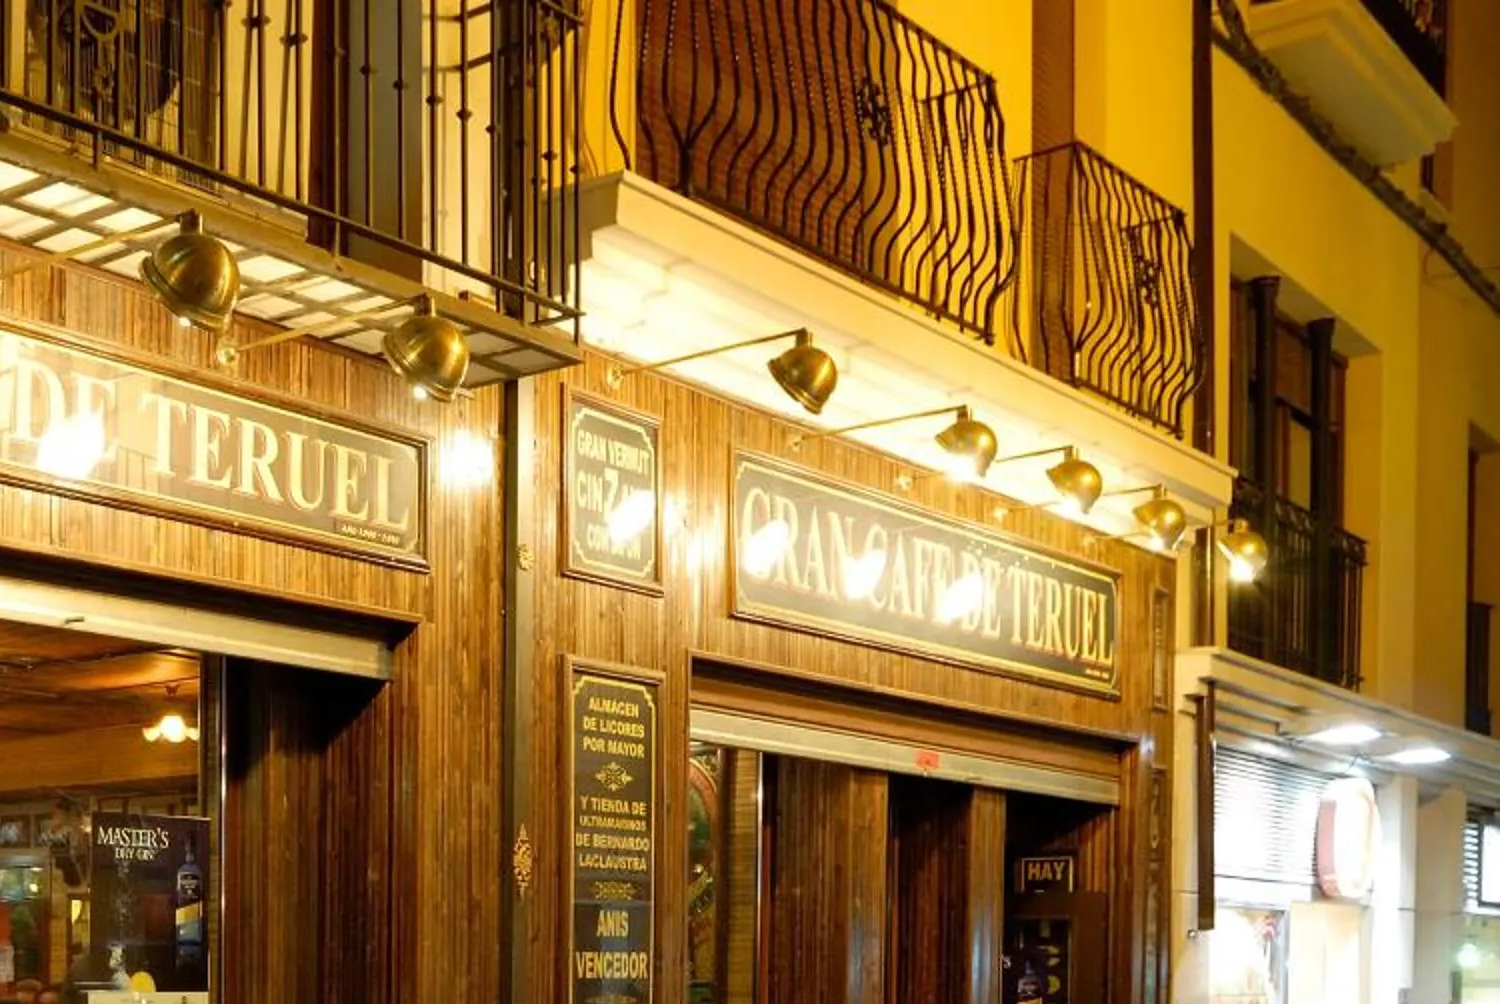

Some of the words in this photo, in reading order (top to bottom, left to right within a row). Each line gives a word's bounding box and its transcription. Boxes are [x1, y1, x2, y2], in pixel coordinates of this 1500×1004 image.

[140, 392, 412, 531] TERUEL
[1008, 567, 1114, 663] TERUEL
[588, 696, 639, 718] ALMACEN
[583, 716, 597, 732] DE
[599, 718, 645, 738] LICORES
[583, 736, 605, 752] POR
[606, 739, 645, 759] MAYOR
[580, 795, 588, 810] Y
[592, 797, 631, 815] TIENDA
[631, 801, 647, 817] DE
[97, 825, 169, 849] MASTER'S
[576, 832, 590, 847] DE
[593, 833, 649, 852] BERNARDO
[1027, 861, 1066, 881] HAY
[596, 910, 629, 937] ANIS
[576, 951, 649, 979] VENCEDOR
